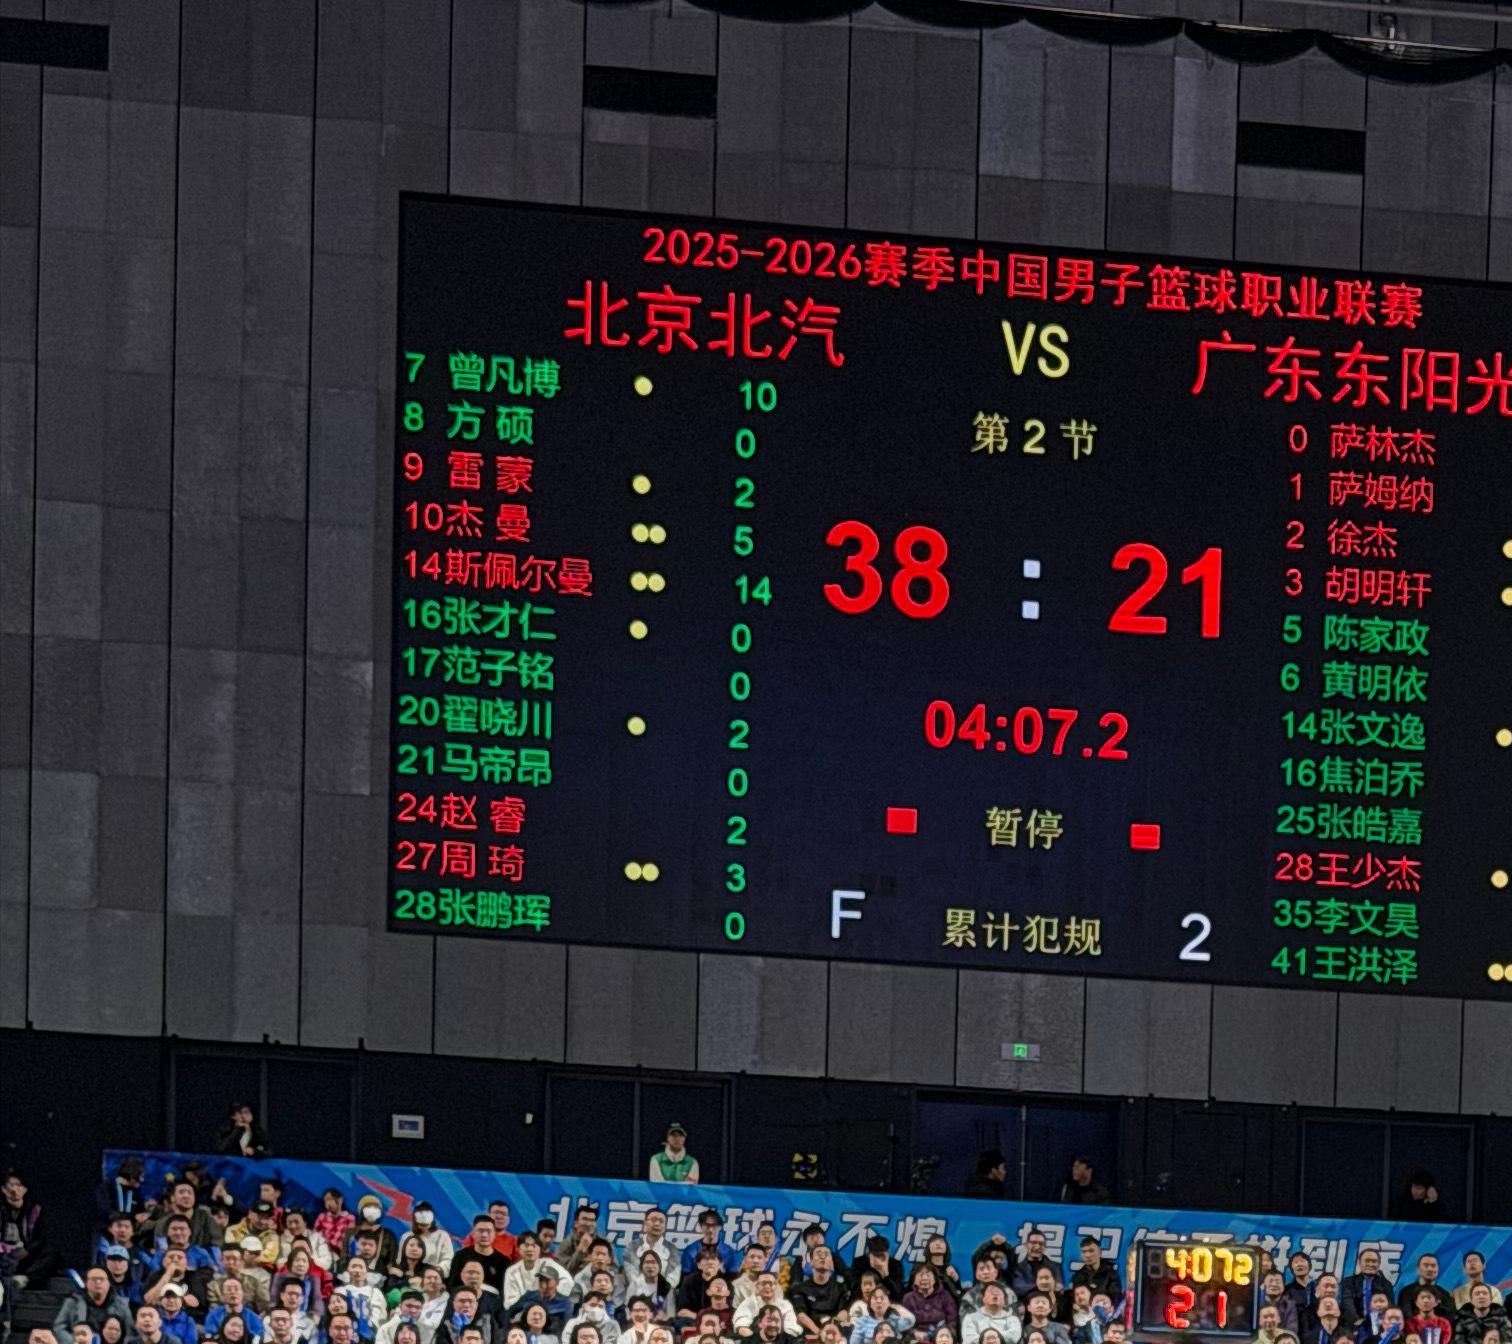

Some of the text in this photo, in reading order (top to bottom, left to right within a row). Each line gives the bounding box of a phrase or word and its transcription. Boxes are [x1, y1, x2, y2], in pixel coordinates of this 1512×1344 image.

[642, 228, 1422, 332] 2025-2026赛季中国男子篮球职业联赛
[564, 280, 844, 366] 北京北汽
[1002, 321, 1069, 377] VS
[407, 353, 776, 411] 7 曾凡博 10
[404, 403, 423, 430] 8
[736, 429, 755, 458] 0
[1290, 425, 1307, 452] 0
[1331, 423, 1435, 465] 萨林杰
[404, 453, 423, 480] 9
[735, 478, 754, 507] 2
[1291, 473, 1301, 500] 1
[1330, 471, 1433, 512] 萨姆纳
[735, 526, 753, 555] 5
[1286, 521, 1304, 549] 2
[1328, 520, 1397, 557] 徐杰
[736, 576, 772, 605] 14
[824, 521, 949, 618] 38
[1108, 543, 1222, 638] 21
[1286, 569, 1302, 595] 3
[1326, 566, 1431, 608] 胡明轩
[732, 624, 751, 652] 0
[1284, 616, 1301, 642] 5
[1325, 615, 1429, 655] 陈家政
[731, 672, 750, 700] 0
[1282, 664, 1299, 690] 6
[1324, 662, 1427, 701] 黄明依
[730, 720, 749, 748] 2
[925, 700, 1128, 760] 04:07.2
[729, 769, 747, 796] 0
[727, 816, 746, 844] 2
[986, 807, 1063, 849] 暂停
[727, 864, 745, 892] 3
[726, 912, 744, 939] 0
[832, 890, 1211, 961] F 累计犯规 2
